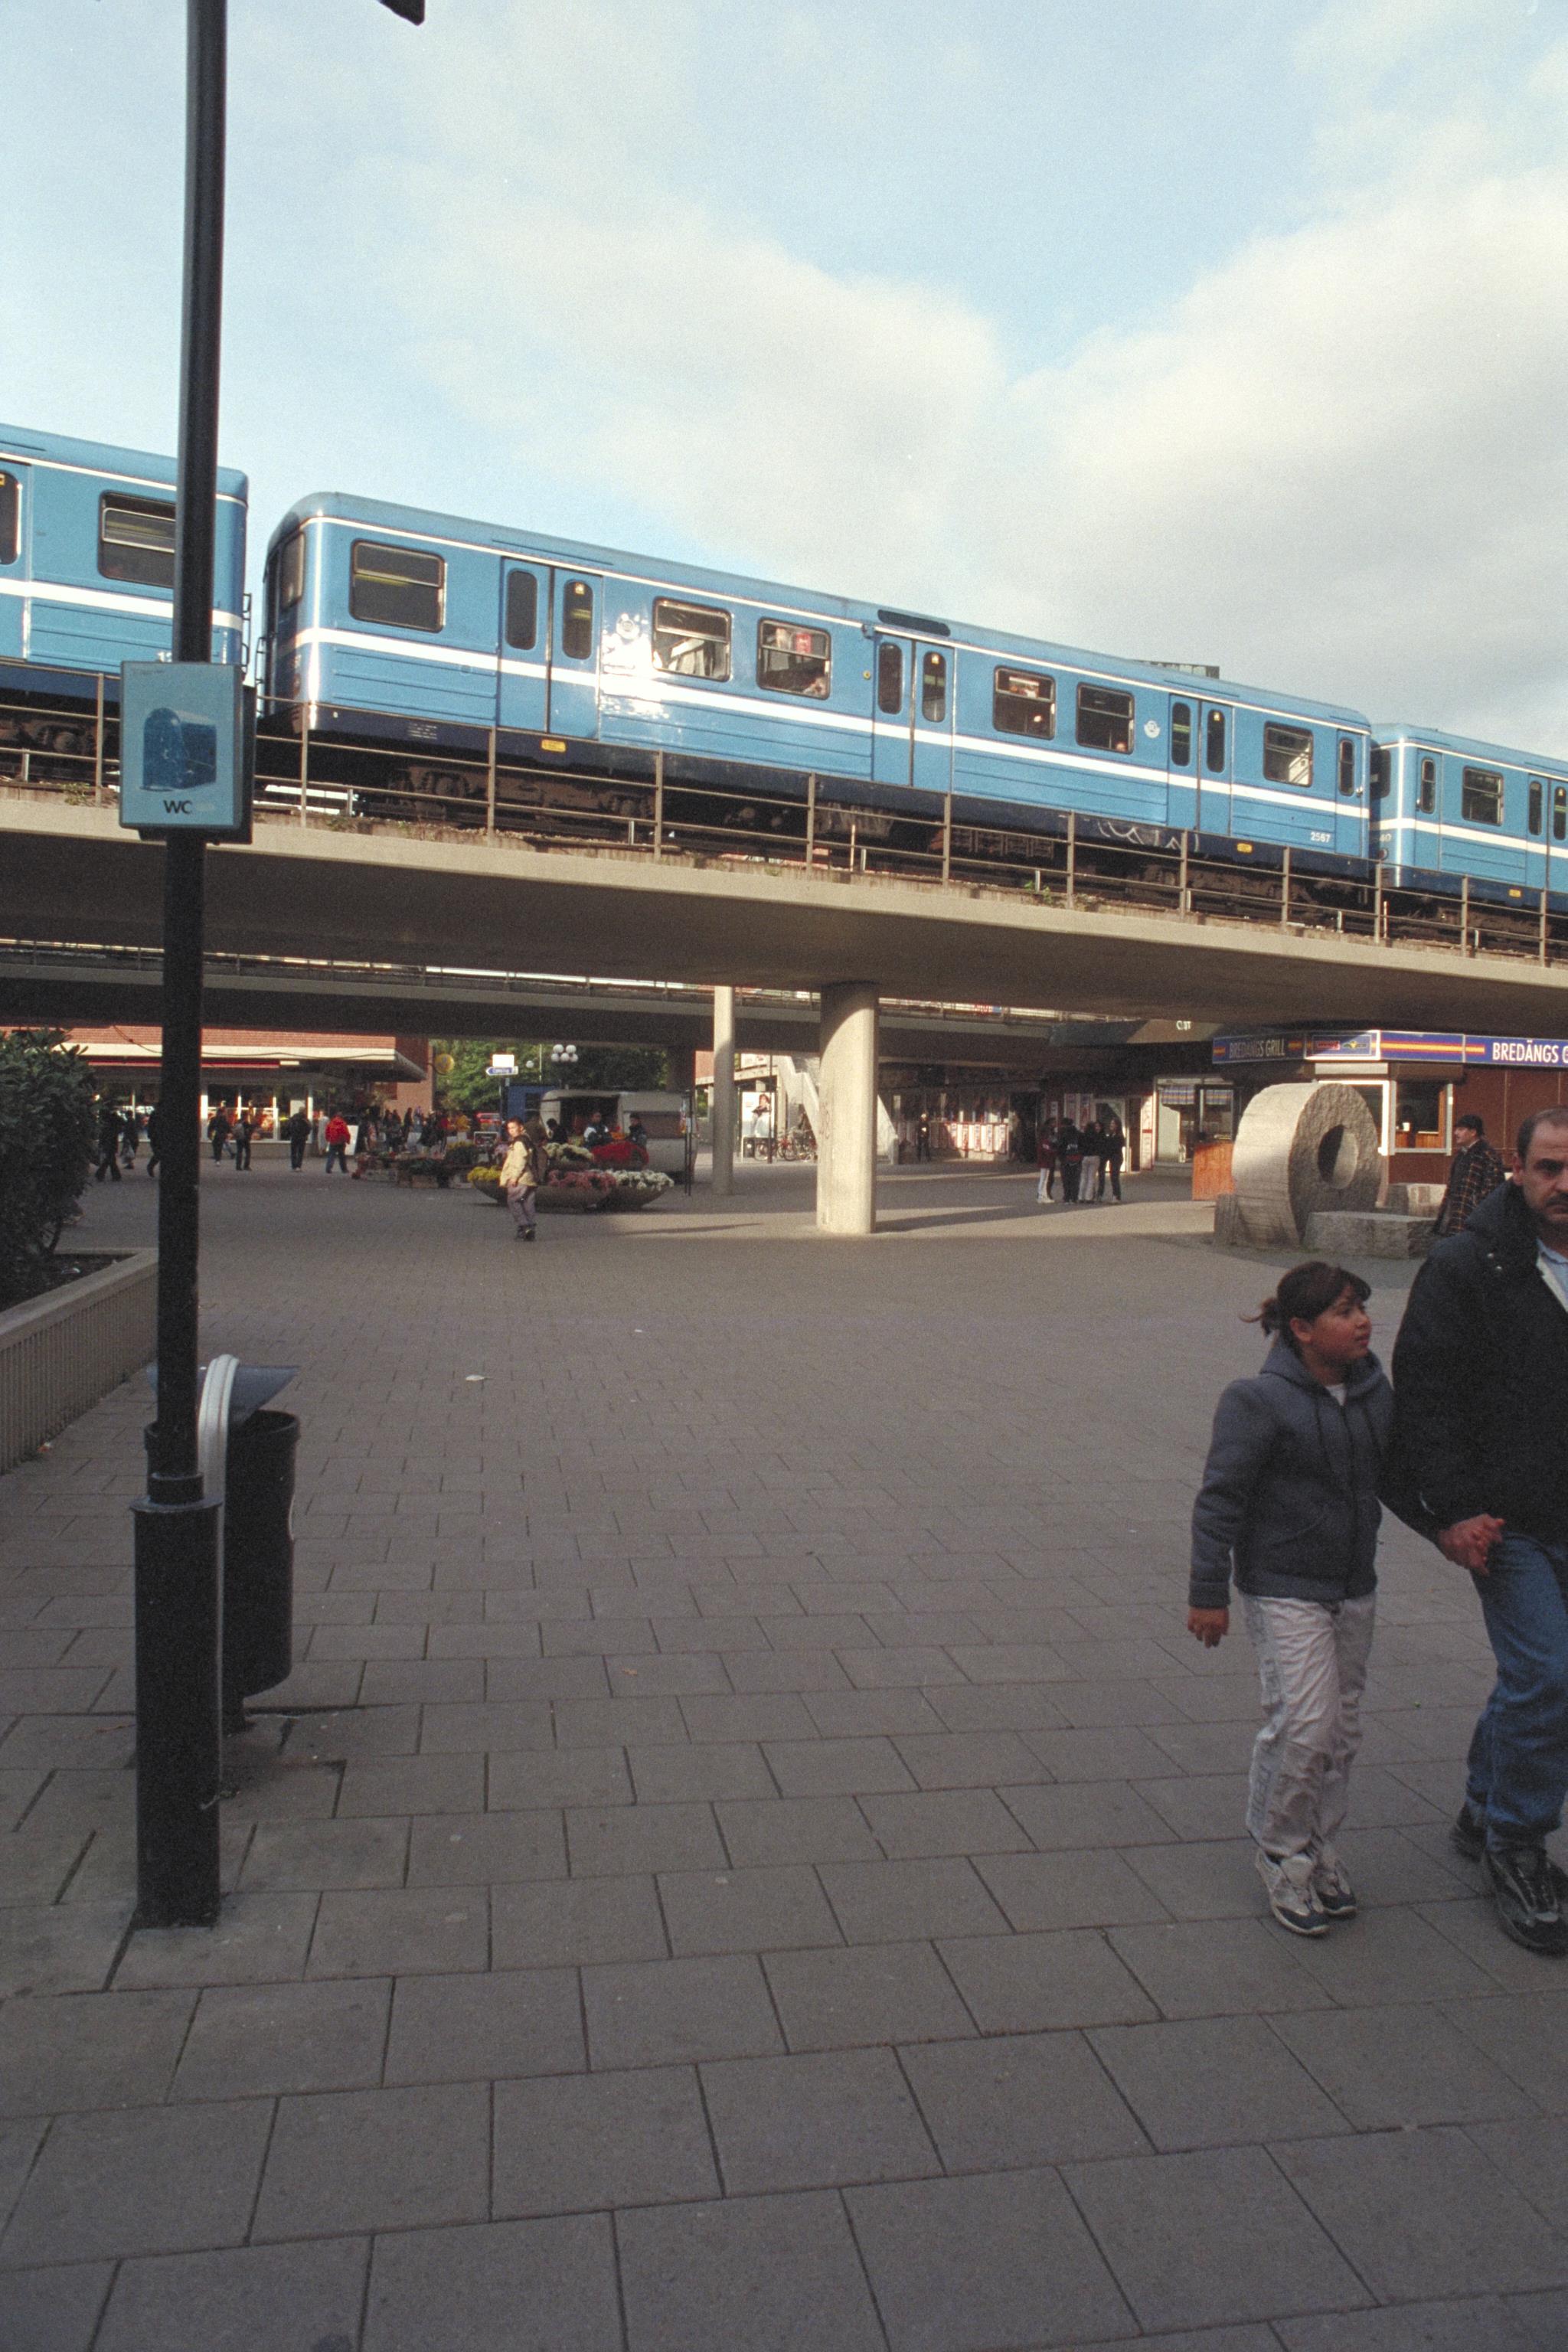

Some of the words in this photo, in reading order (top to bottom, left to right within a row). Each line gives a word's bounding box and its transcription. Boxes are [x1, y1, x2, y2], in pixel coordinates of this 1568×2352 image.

[163, 800, 193, 814] WC
[1266, 1038, 1285, 1057] GRILL
[1492, 1040, 1559, 1063] BREDÄNGS
